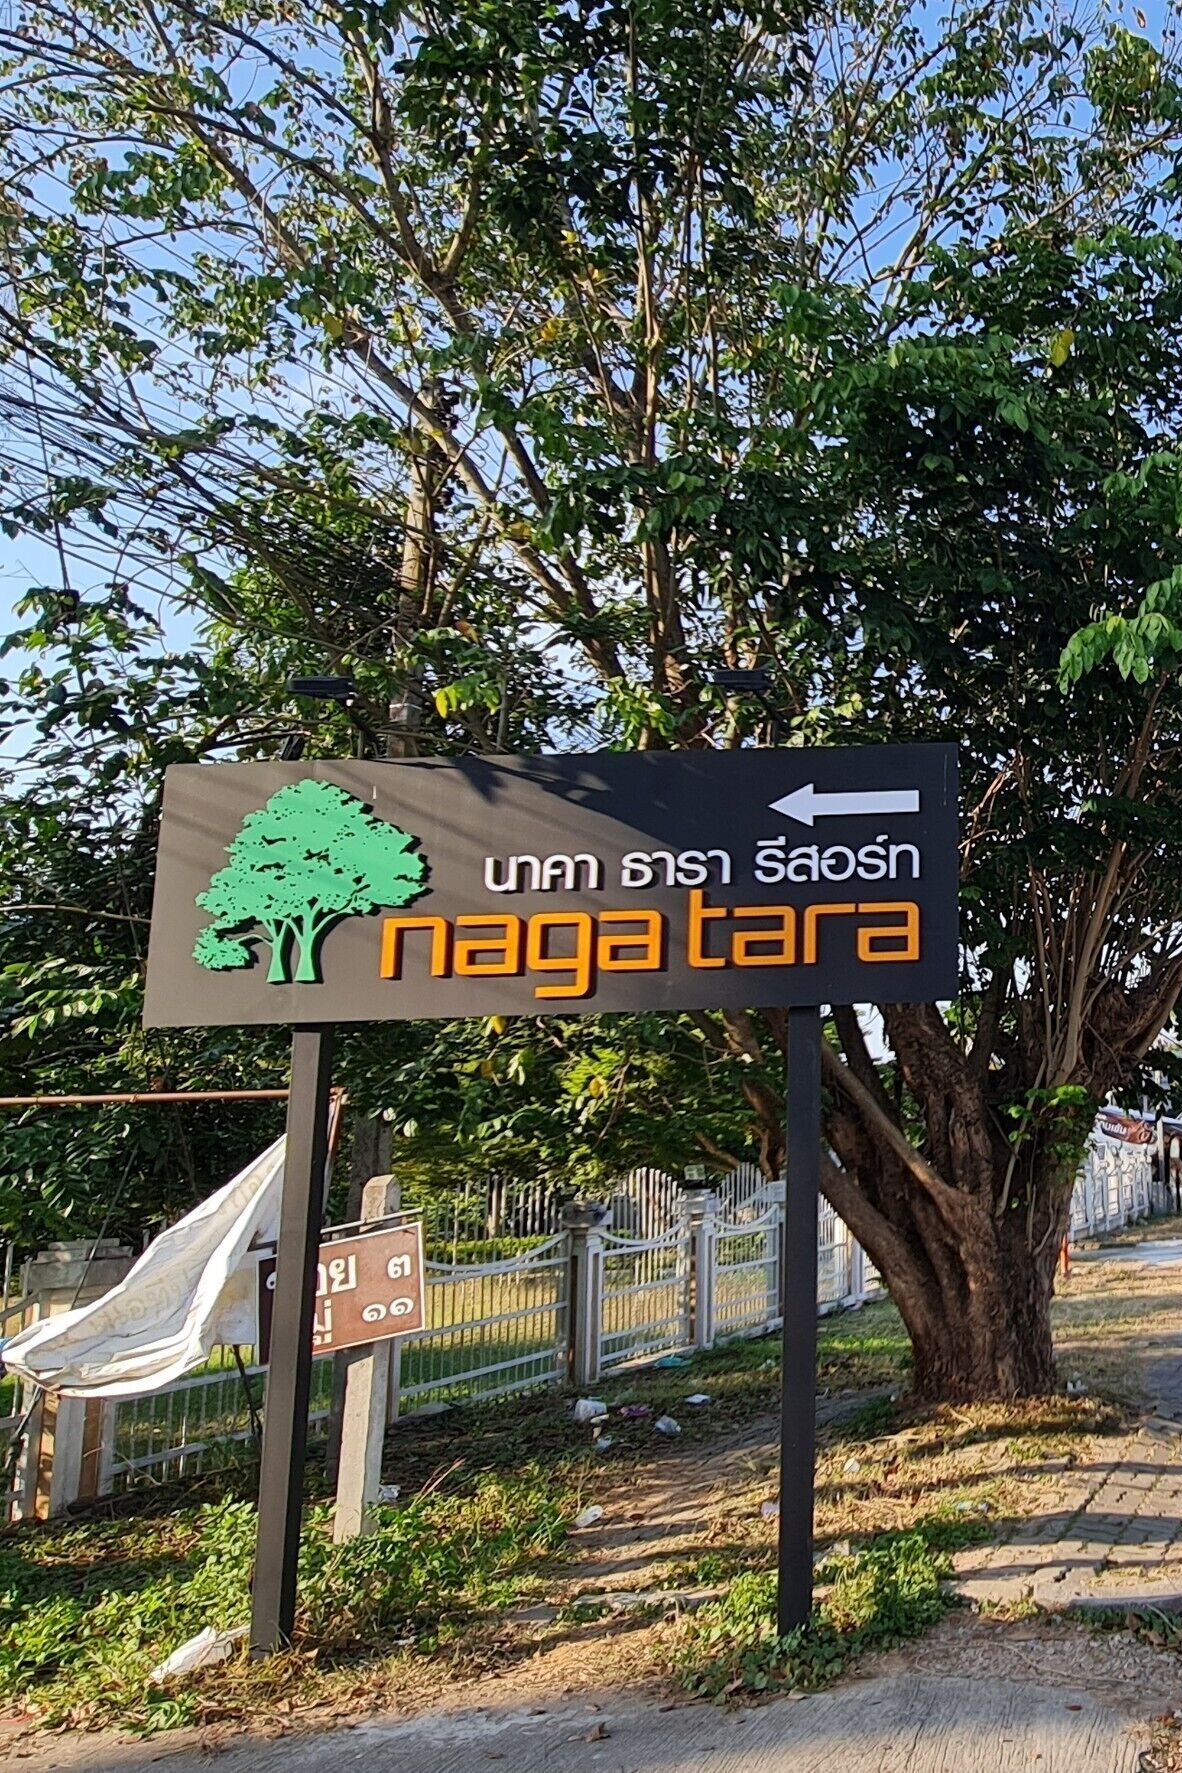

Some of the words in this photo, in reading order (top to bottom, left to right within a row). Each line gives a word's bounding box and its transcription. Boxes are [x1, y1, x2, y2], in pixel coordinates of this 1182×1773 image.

[484, 852, 599, 893] นาคา
[620, 847, 732, 888] ธารา
[753, 833, 922, 884] รีสอร์ท
[387, 1254, 411, 1279] ๓
[361, 1297, 414, 1322] ๑๑
